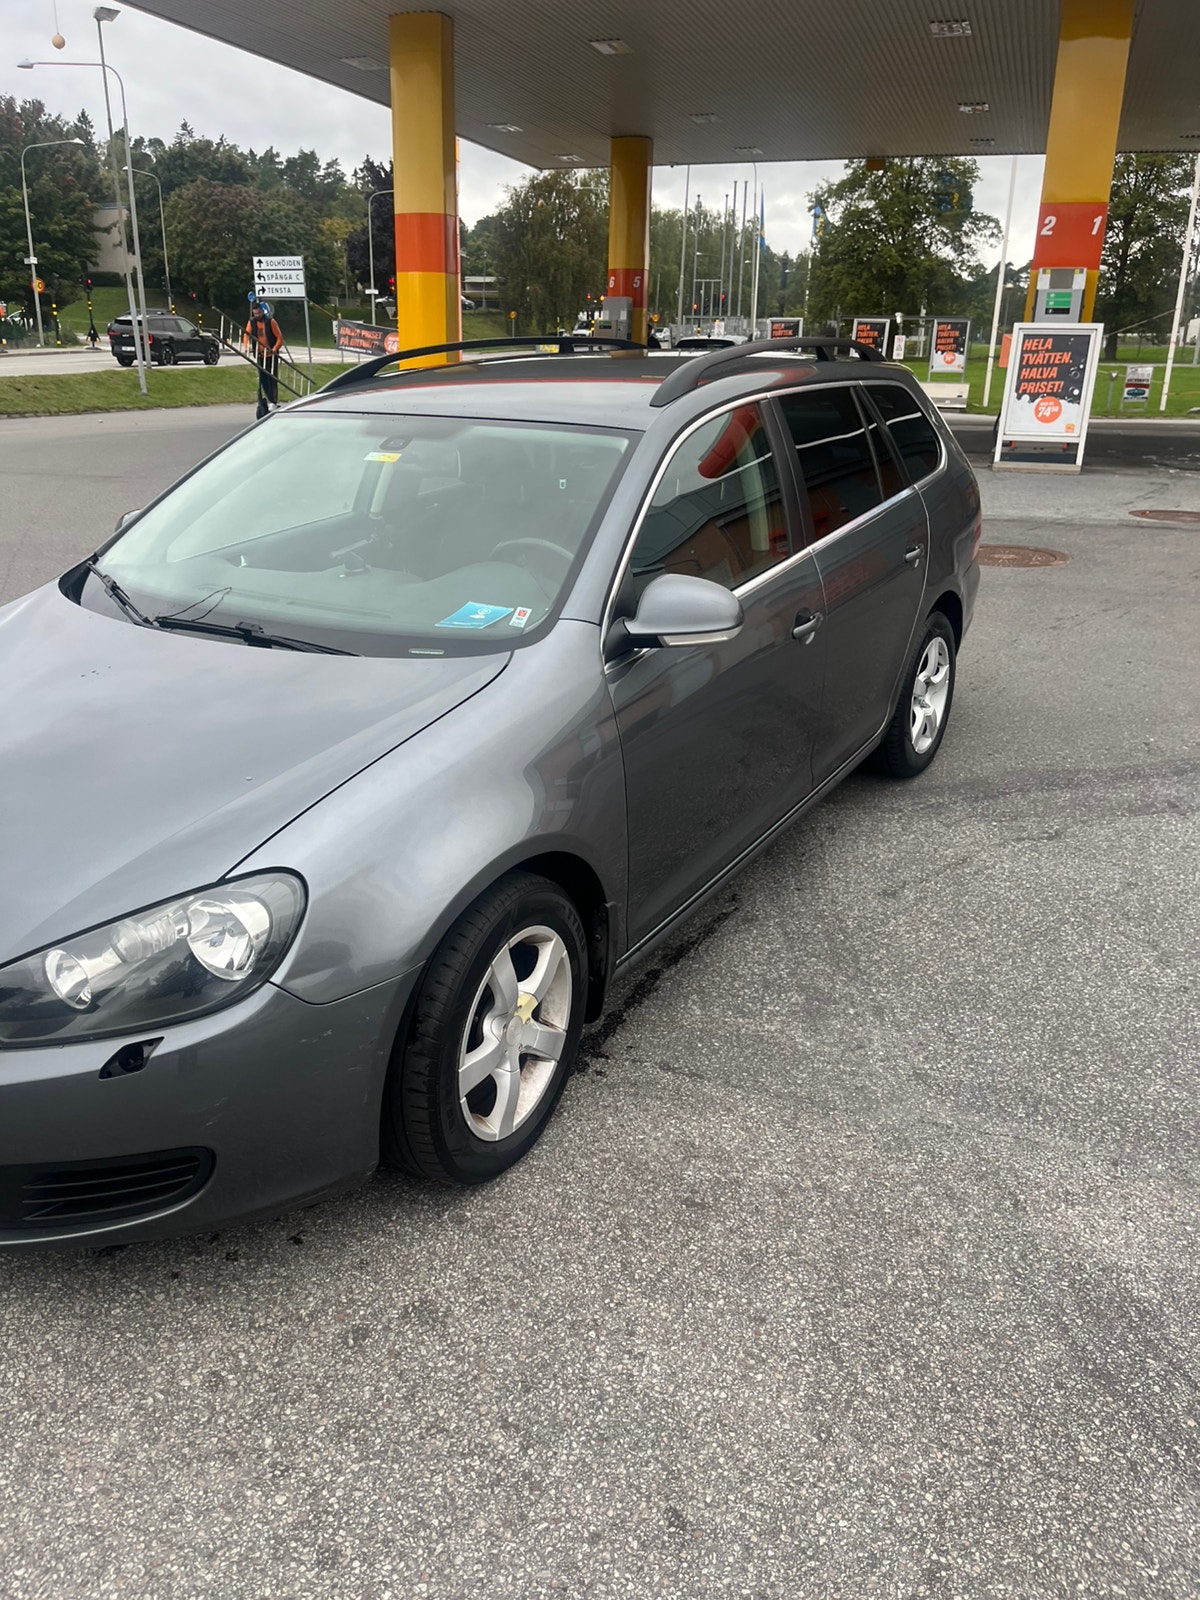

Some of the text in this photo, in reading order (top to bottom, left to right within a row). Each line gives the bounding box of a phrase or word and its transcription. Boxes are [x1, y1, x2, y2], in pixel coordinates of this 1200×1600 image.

[1040, 215, 1057, 236] 2
[1091, 215, 1103, 236] 1
[265, 259, 301, 267] SOLHÖJDEN
[266, 273, 293, 281] SPÅNGA
[609, 276, 616, 288] 6
[633, 276, 642, 288] 5
[1022, 338, 1053, 351] HELA
[1022, 350, 1073, 366] TVÄTTEN.
[1020, 366, 1058, 380] HALVA
[1018, 381, 1065, 394] PRISET!
